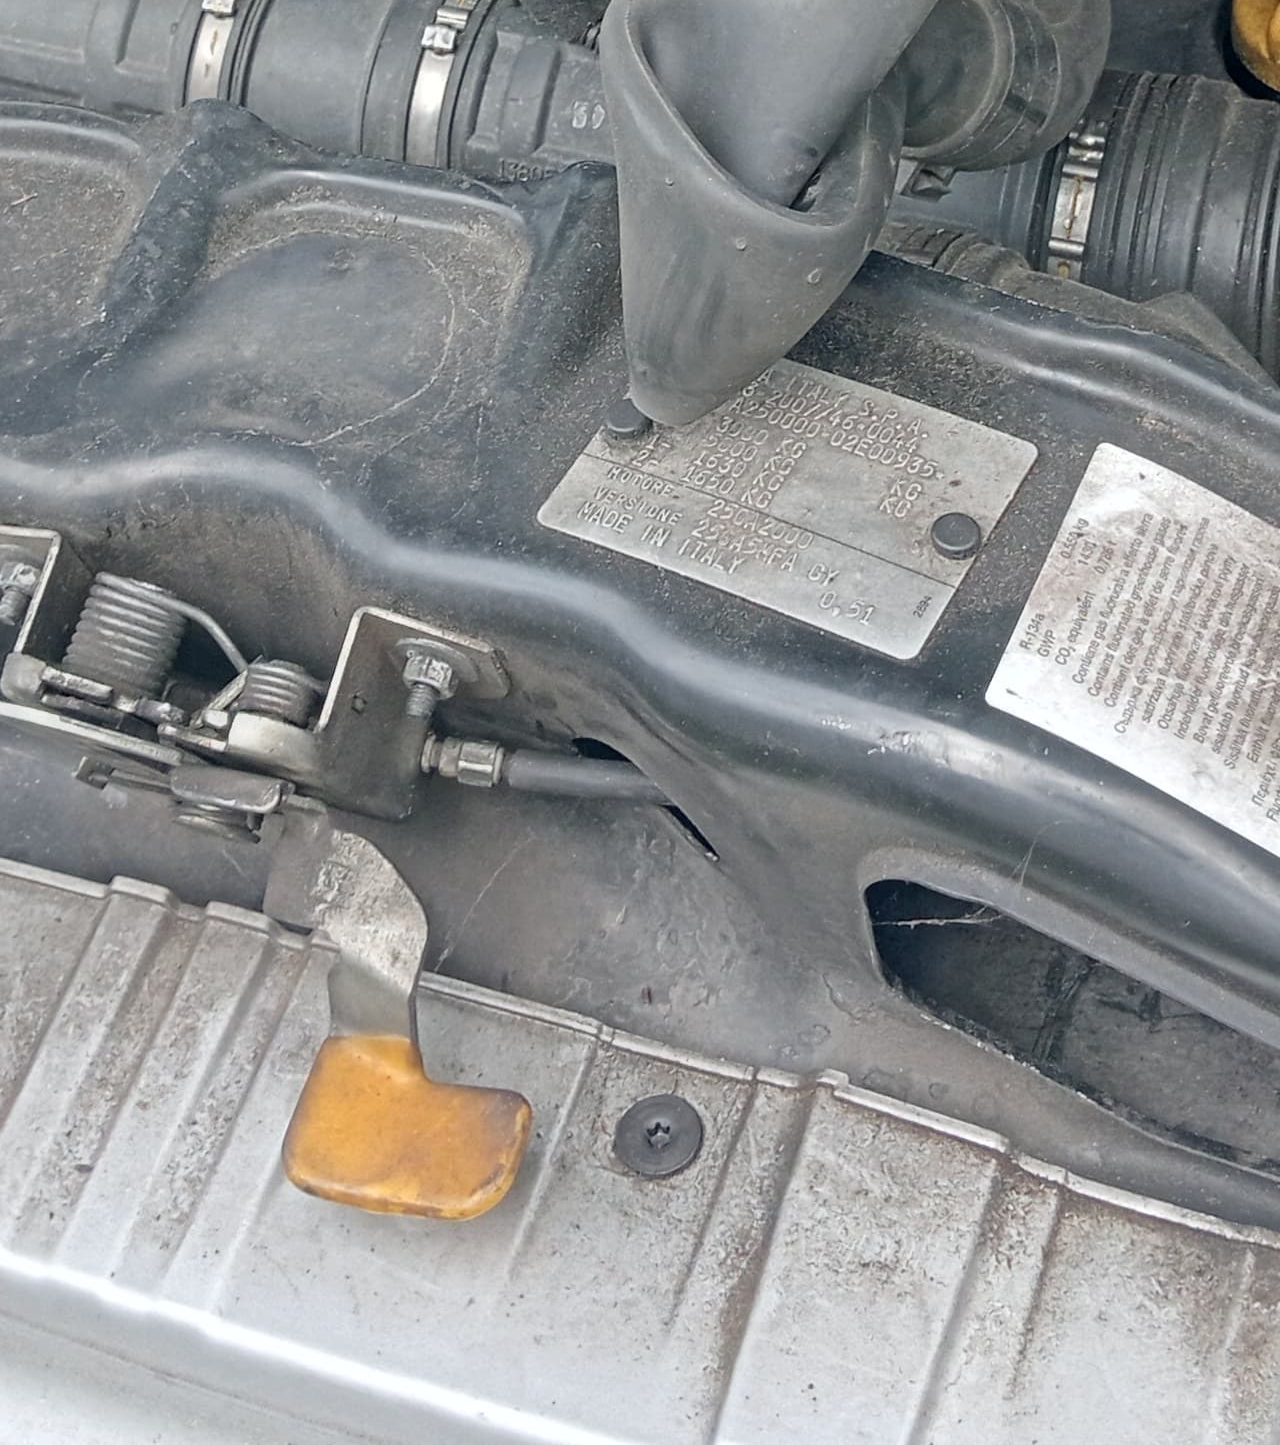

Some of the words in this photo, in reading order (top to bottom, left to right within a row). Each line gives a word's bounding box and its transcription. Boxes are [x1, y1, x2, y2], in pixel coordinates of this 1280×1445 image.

[764, 455, 796, 476] KG
[776, 438, 807, 459] KG
[681, 465, 736, 496] 1650
[741, 487, 773, 509] KG
[693, 450, 748, 478] 1630
[753, 470, 784, 492] KG
[889, 479, 922, 501] KG
[593, 484, 683, 526] VERSIONE
[880, 496, 912, 518] KG
[576, 500, 633, 535] MADE
[640, 523, 672, 548] IN
[677, 537, 745, 575] ITALY
[1065, 589, 1098, 645] equivalent
[1087, 650, 1115, 699] Contains
[1151, 514, 1174, 546] gases
[1019, 610, 1045, 651] R-134a
[1037, 628, 1058, 659] GWP
[1072, 637, 1101, 686] Contiene
[1093, 618, 1111, 641] gas
[1103, 661, 1132, 710] Contient
[1122, 644, 1139, 665] des
